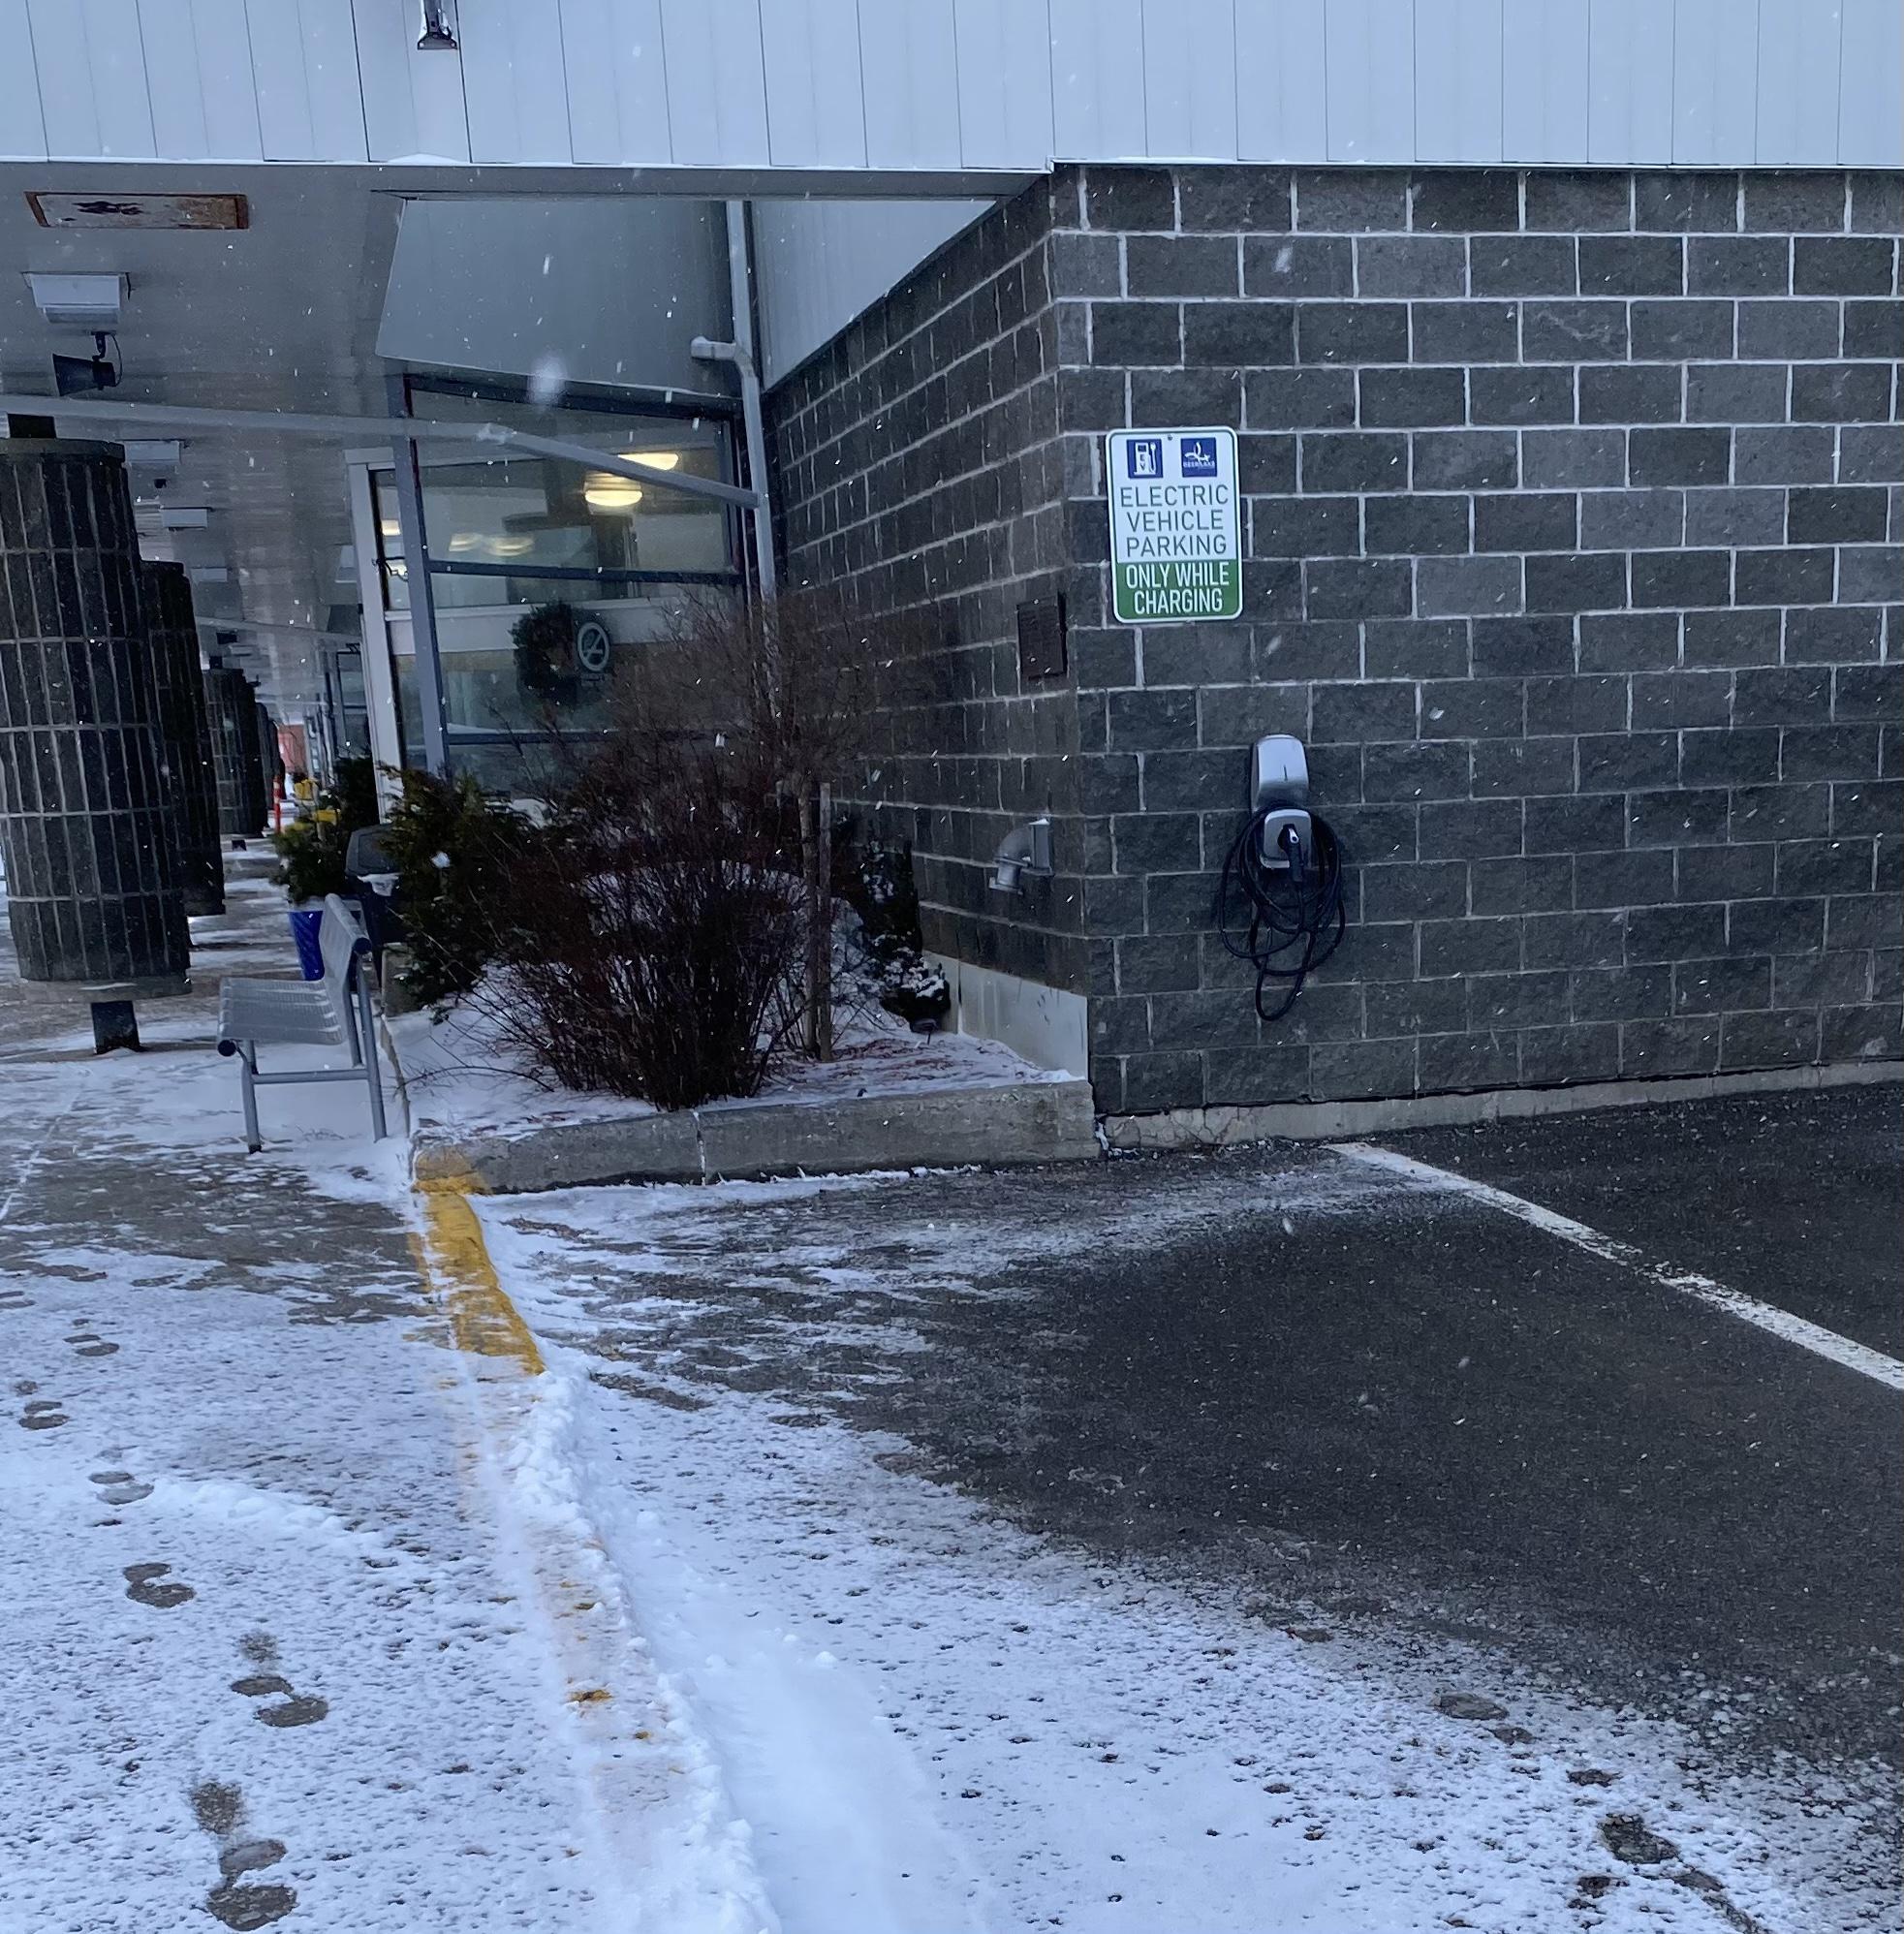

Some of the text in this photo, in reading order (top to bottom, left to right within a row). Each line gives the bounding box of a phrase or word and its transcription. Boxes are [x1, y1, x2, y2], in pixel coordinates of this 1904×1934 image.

[1120, 484, 1229, 508] ELECTRIC
[1126, 510, 1224, 532] VEHICLE
[1126, 535, 1227, 557] PARKING
[1126, 562, 1230, 589] ONLY WHILE
[1134, 588, 1223, 614] CHARGING
